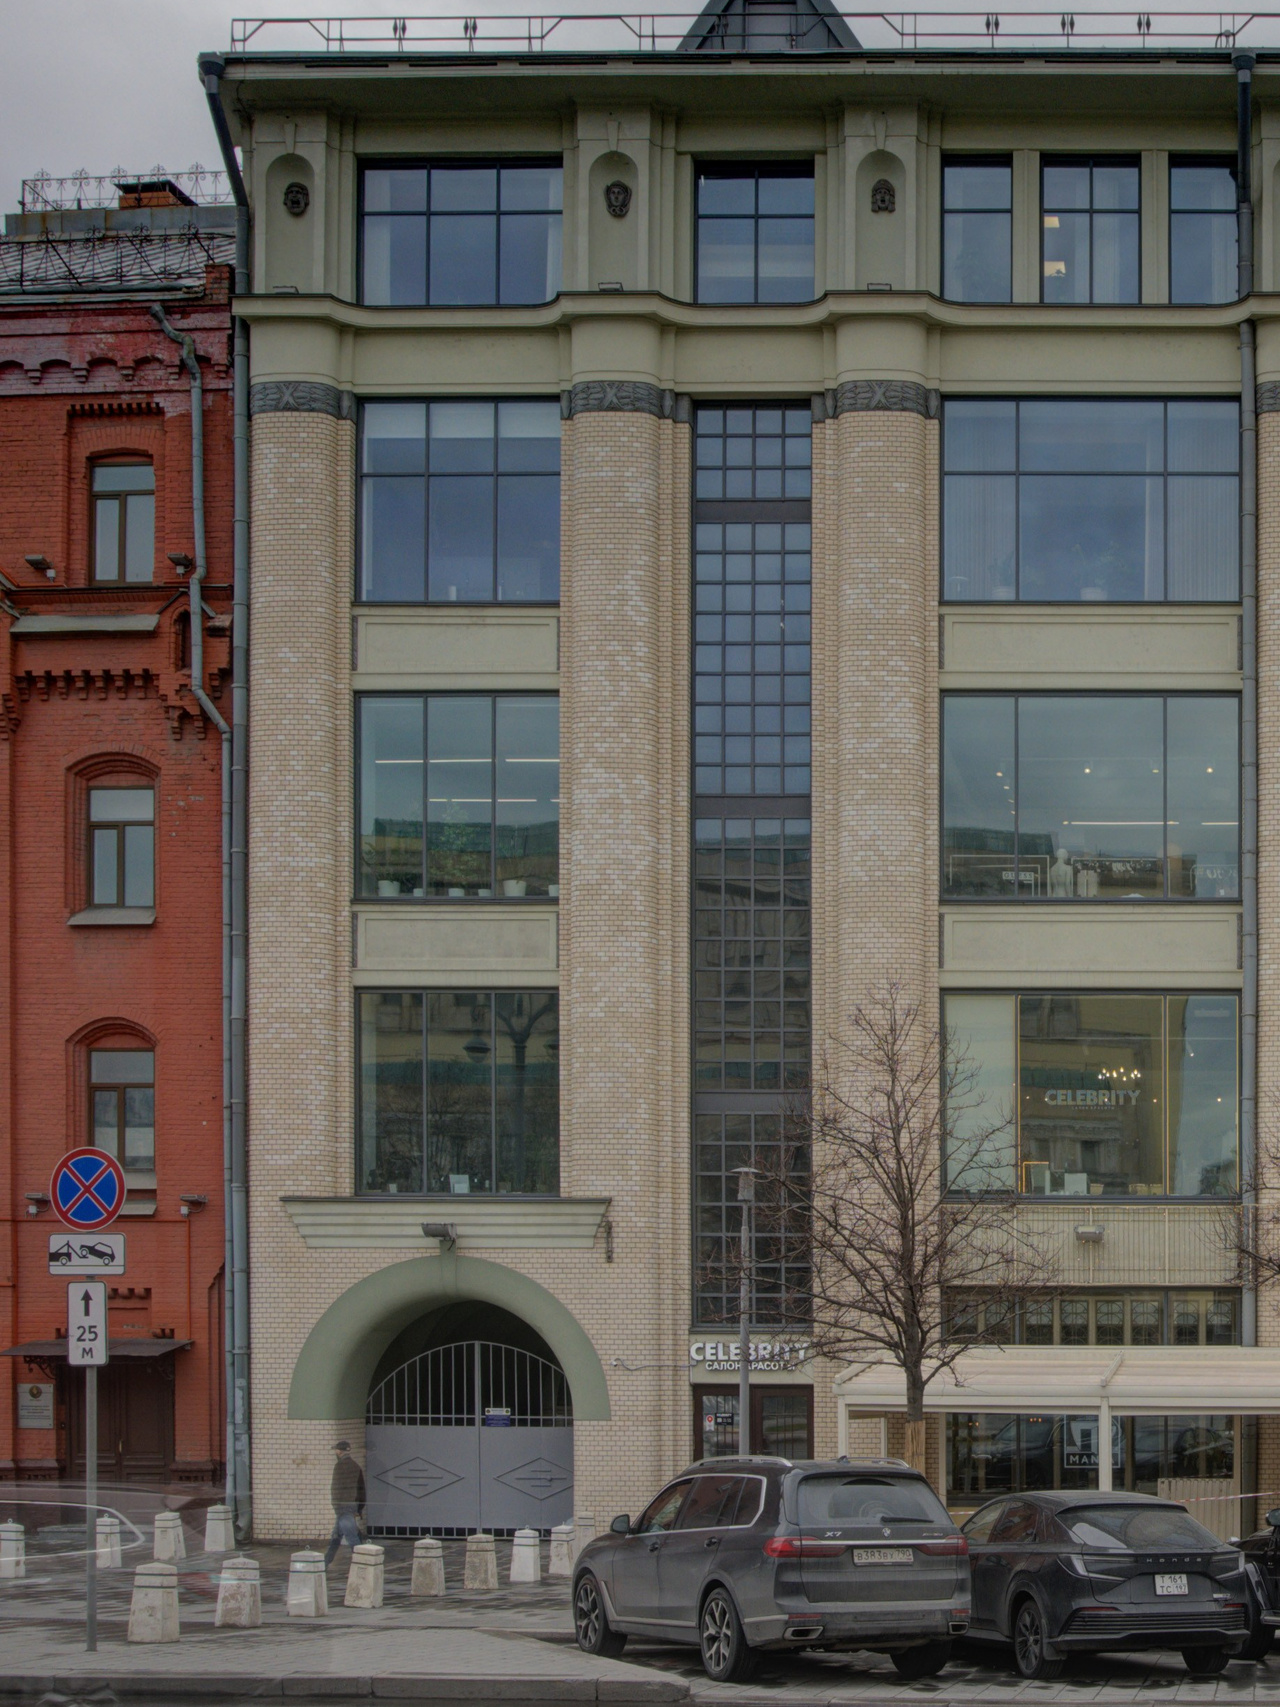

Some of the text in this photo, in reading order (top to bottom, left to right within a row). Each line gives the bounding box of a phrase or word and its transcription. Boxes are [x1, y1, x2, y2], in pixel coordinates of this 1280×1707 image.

[1045, 1089, 1141, 1105] CELEBRITY
[76, 1326, 98, 1342] 25
[690, 1342, 810, 1361] CELEBRITY
